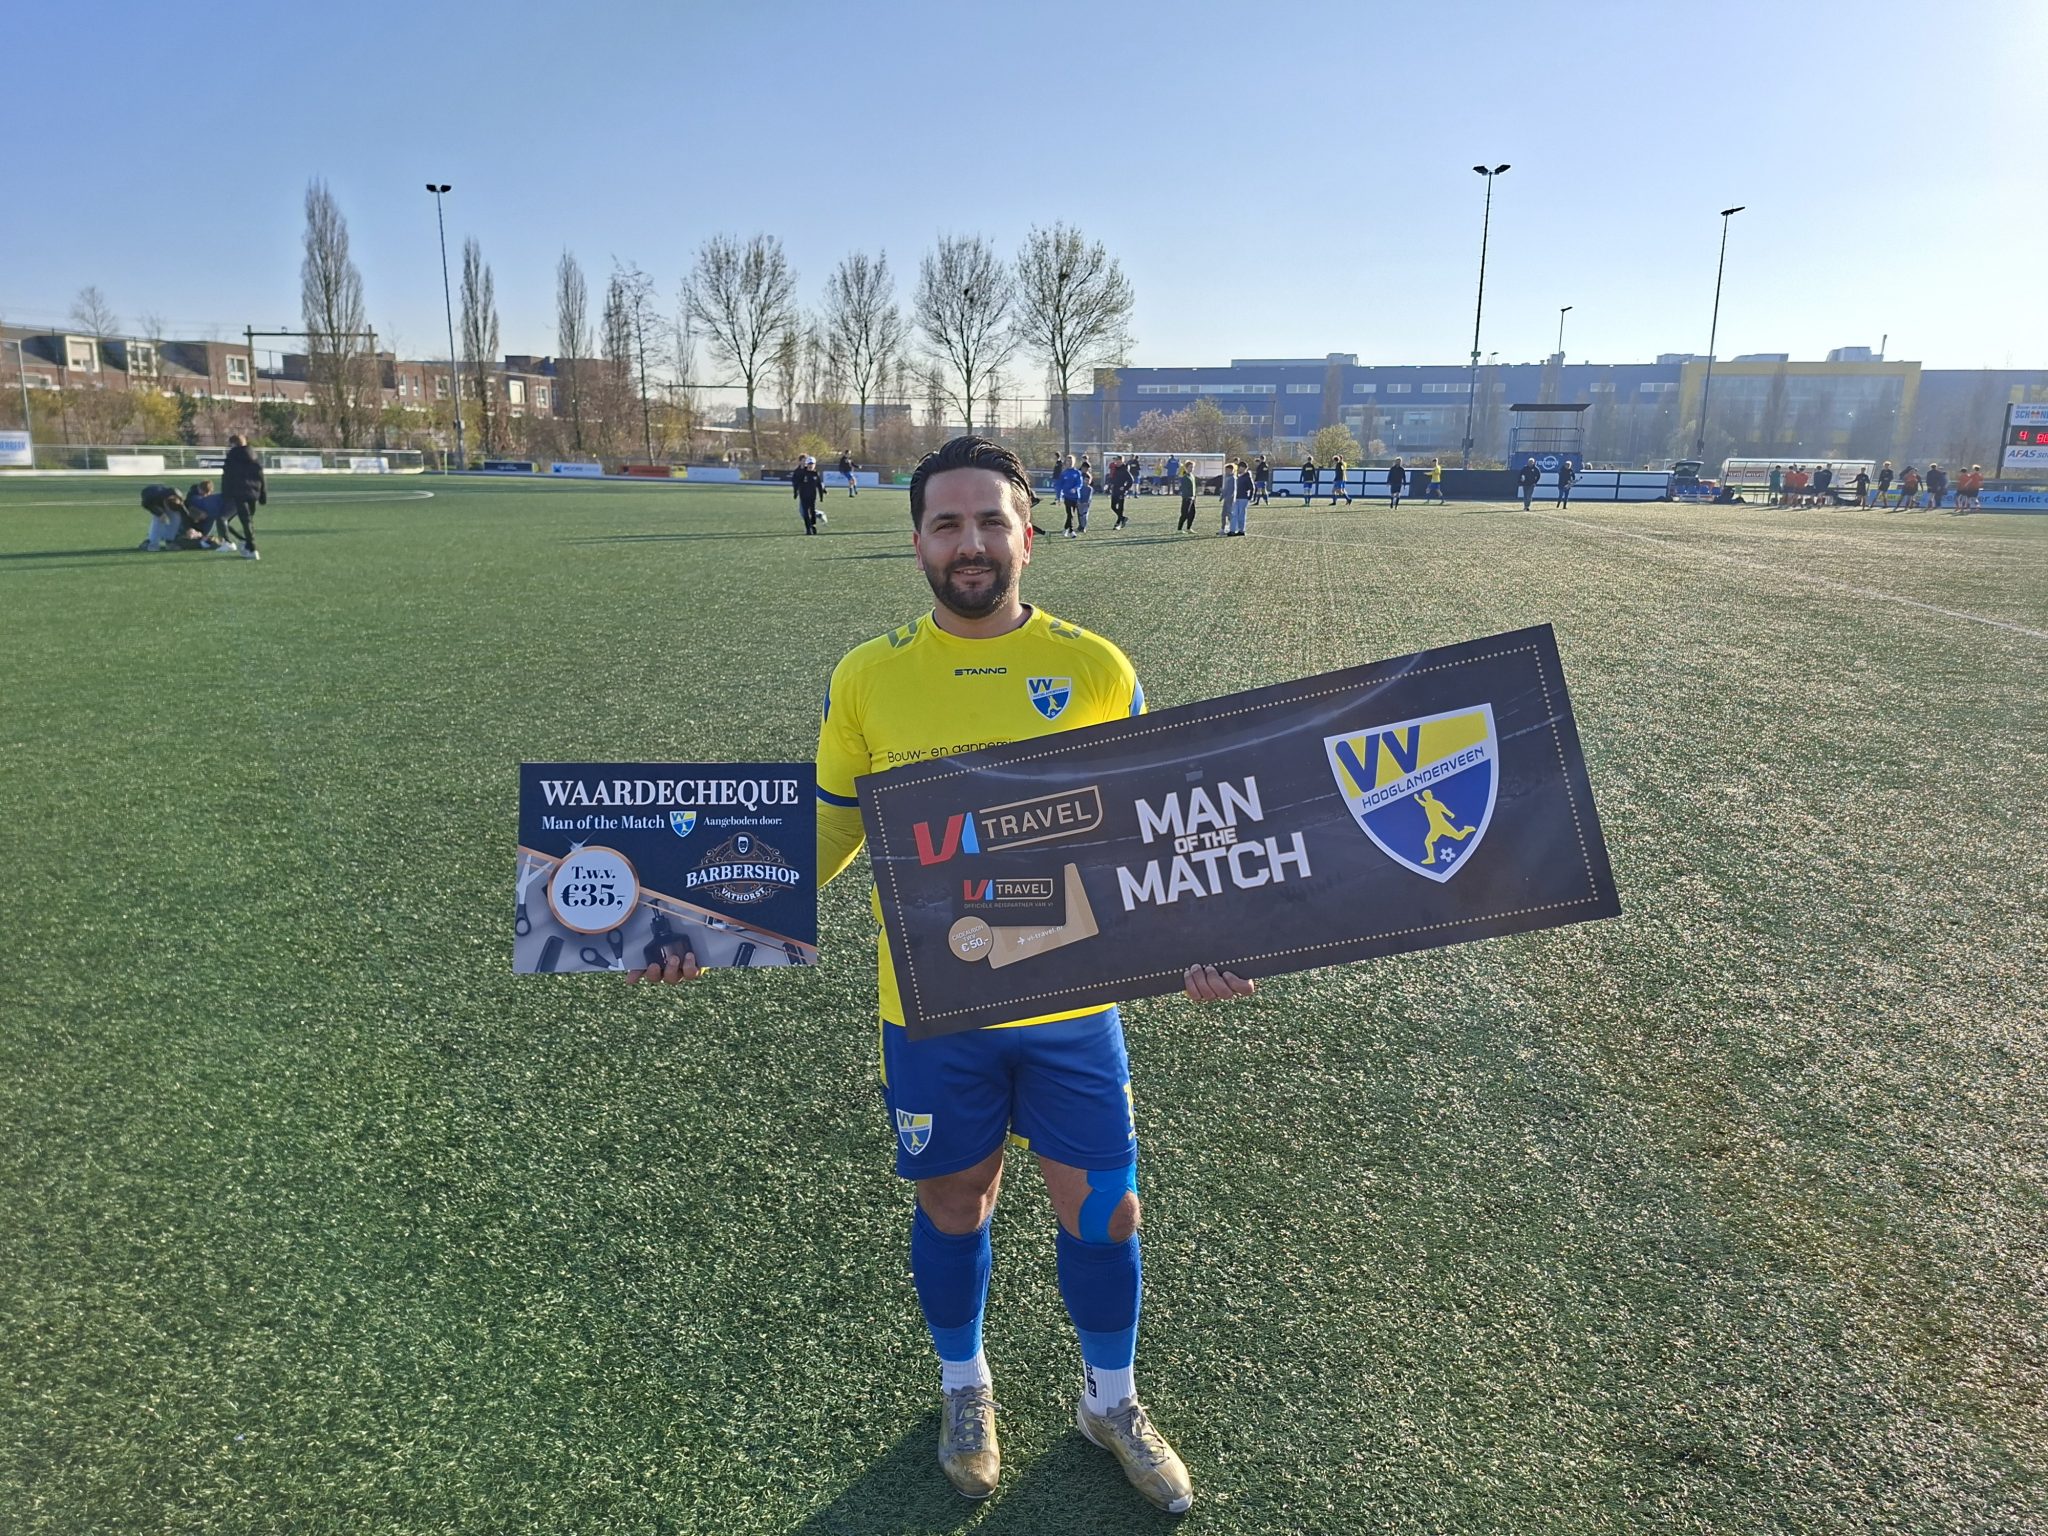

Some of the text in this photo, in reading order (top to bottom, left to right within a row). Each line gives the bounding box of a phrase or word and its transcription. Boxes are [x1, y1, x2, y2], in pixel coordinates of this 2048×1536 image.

[2007, 449, 2037, 458] AFAS
[1993, 494, 2014, 503] dan
[2017, 494, 2042, 504] inkt
[954, 667, 1007, 676] STANNO
[887, 746, 928, 763] Bouw-
[930, 746, 949, 758] en
[1362, 746, 1485, 809] HOOGLANDERVEEN
[539, 779, 799, 812] WAARDECHEQUE
[1134, 775, 1265, 845] MAN
[541, 814, 665, 830] Man of the Match
[703, 815, 783, 828] Aangeboden door:
[981, 800, 1093, 840] TRAVEL
[1174, 827, 1239, 854] OF THE
[571, 865, 617, 880] T.w.v.
[685, 863, 801, 889] BARBERSHOP
[1115, 831, 1312, 912] MATCH
[720, 886, 766, 901] VATHORST
[995, 883, 1048, 895] TRAVEL
[961, 942, 970, 952] €
